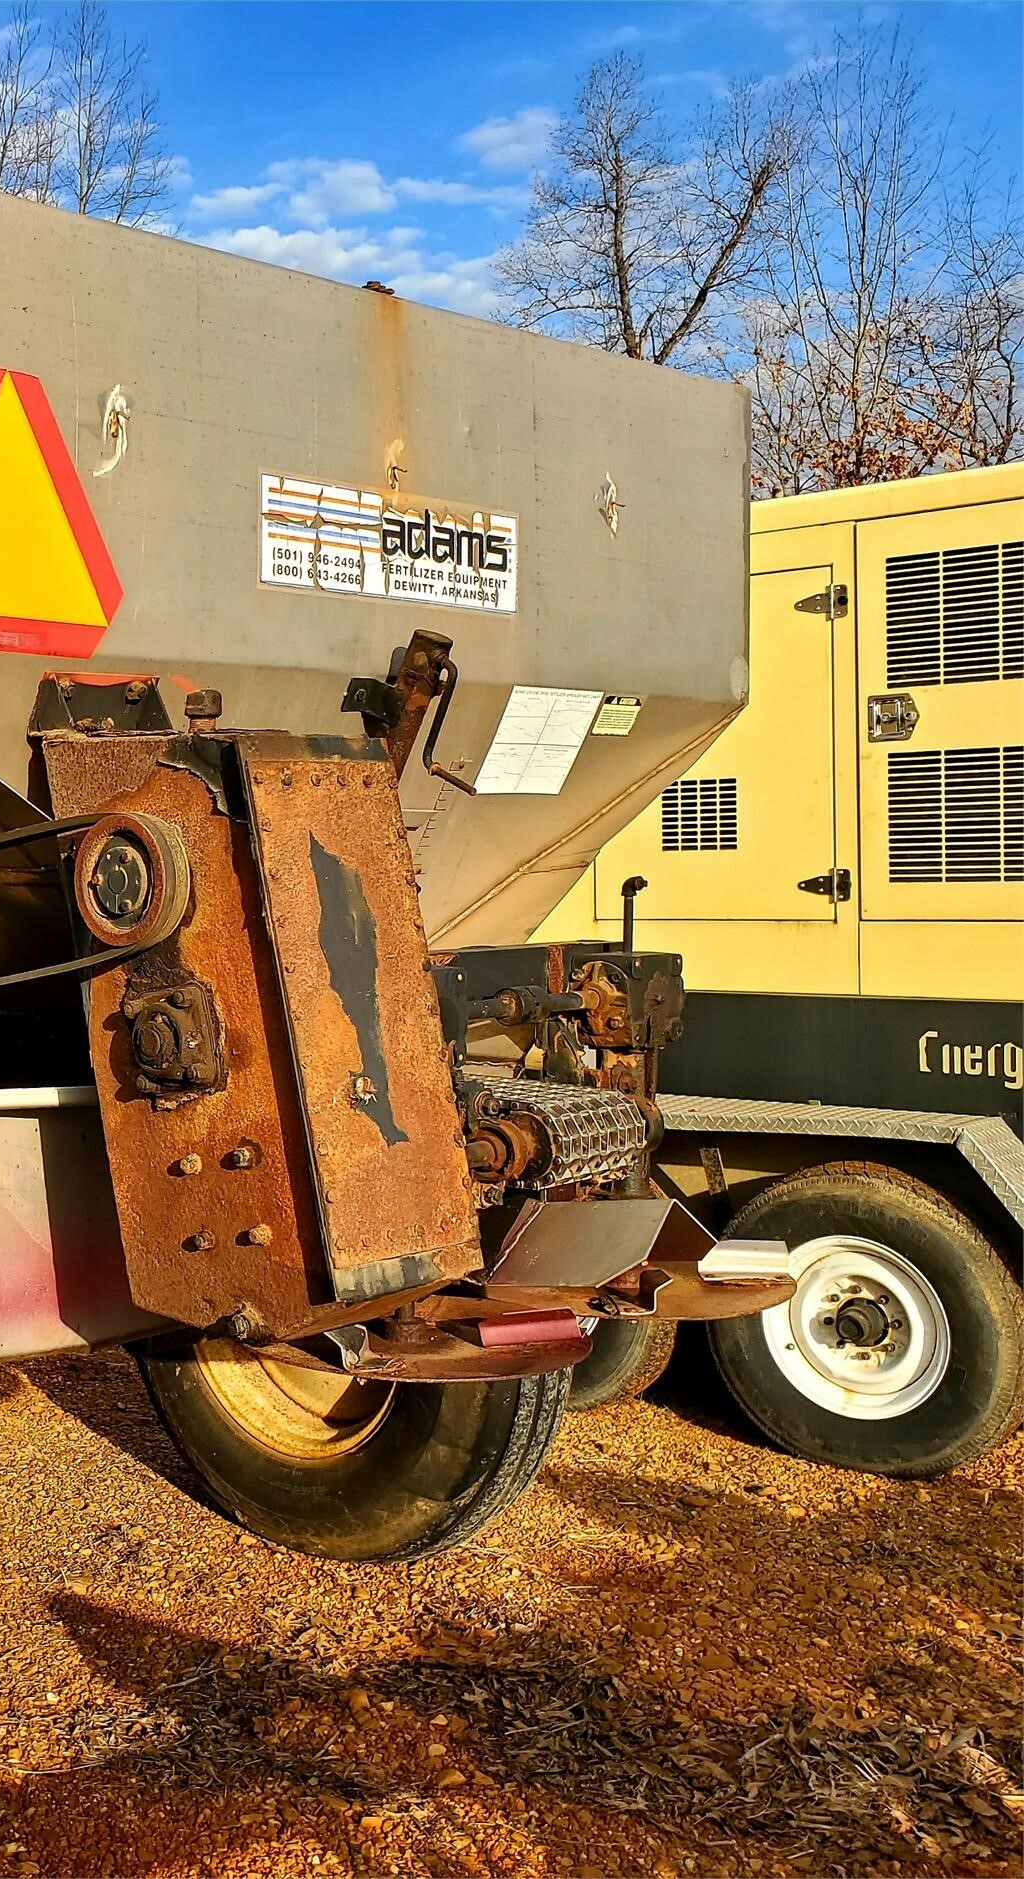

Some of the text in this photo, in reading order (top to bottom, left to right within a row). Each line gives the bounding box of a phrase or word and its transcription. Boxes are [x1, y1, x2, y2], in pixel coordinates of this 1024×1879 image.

[382, 508, 508, 573] adams
[272, 546, 361, 570] (501) 946-2494
[272, 563, 362, 586] (800) 643-4266
[381, 563, 508, 590] FERTILIZER EQUIPMENT
[394, 580, 497, 603] DEWITT, ARKANSAS
